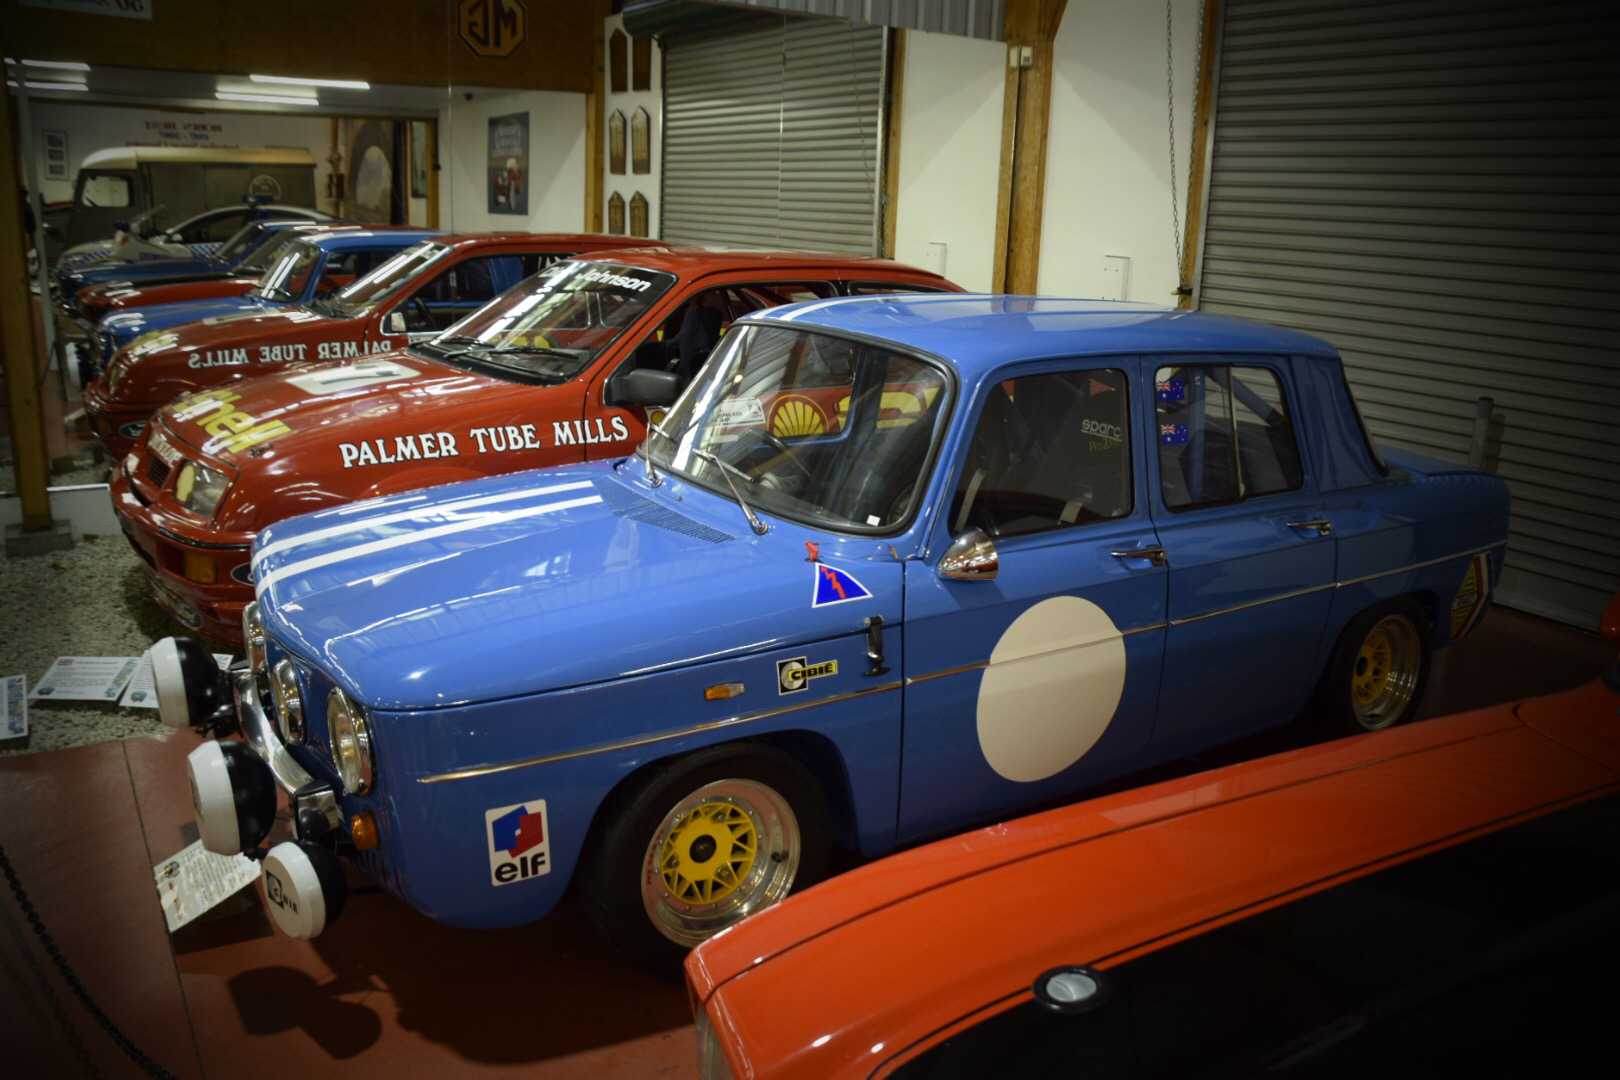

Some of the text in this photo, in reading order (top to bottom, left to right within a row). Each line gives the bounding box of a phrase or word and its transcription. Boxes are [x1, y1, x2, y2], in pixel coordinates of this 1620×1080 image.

[338, 415, 630, 468] PALMER TUBE MILLS
[494, 852, 546, 883] elf
